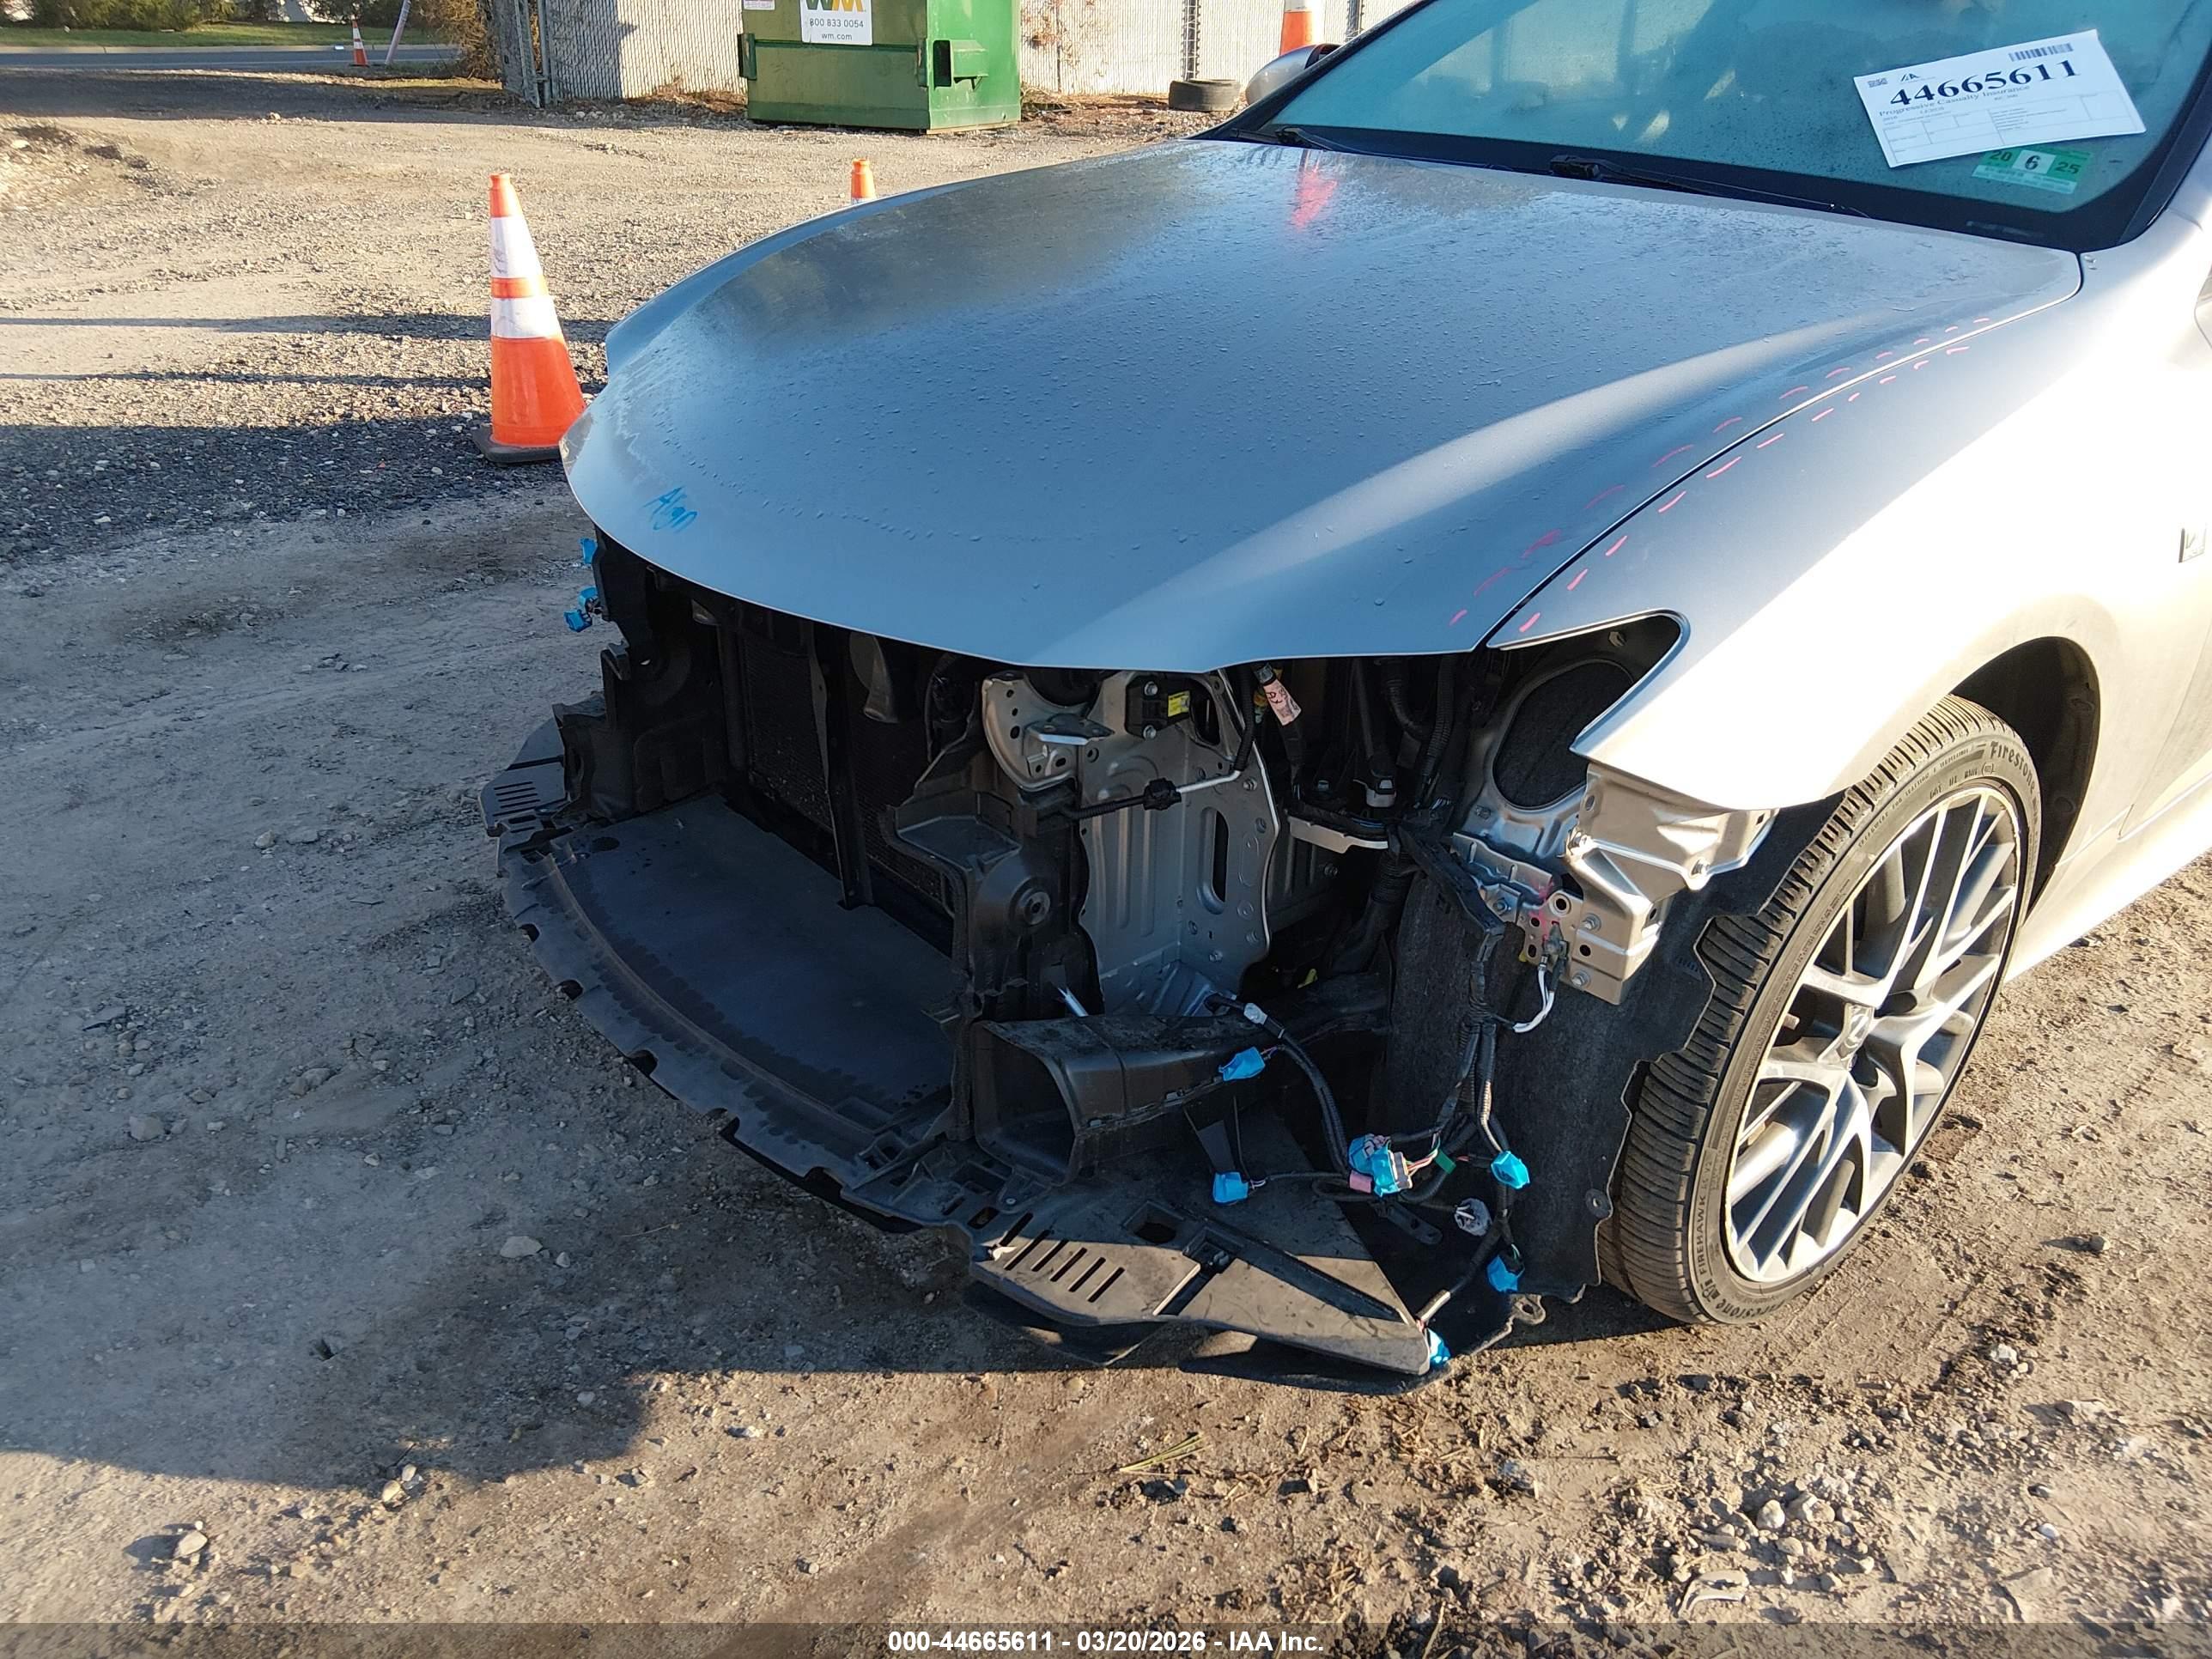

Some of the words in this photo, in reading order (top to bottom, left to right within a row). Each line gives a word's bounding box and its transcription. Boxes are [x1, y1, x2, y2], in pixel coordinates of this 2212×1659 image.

[810, 18, 824, 27] 800
[827, 19, 841, 27] 833
[844, 19, 864, 28] 0054
[1879, 102, 1936, 117] Progressive
[1937, 94, 1979, 105] Casualty
[1983, 84, 2030, 98] Insurance
[1890, 60, 2081, 106] 44665611
[1990, 150, 2012, 161] 20
[2024, 155, 2041, 170] 6
[2056, 161, 2082, 174] 25
[1990, 740, 2036, 794] Firestone
[1696, 1195, 1707, 1276] FIREHAWK
